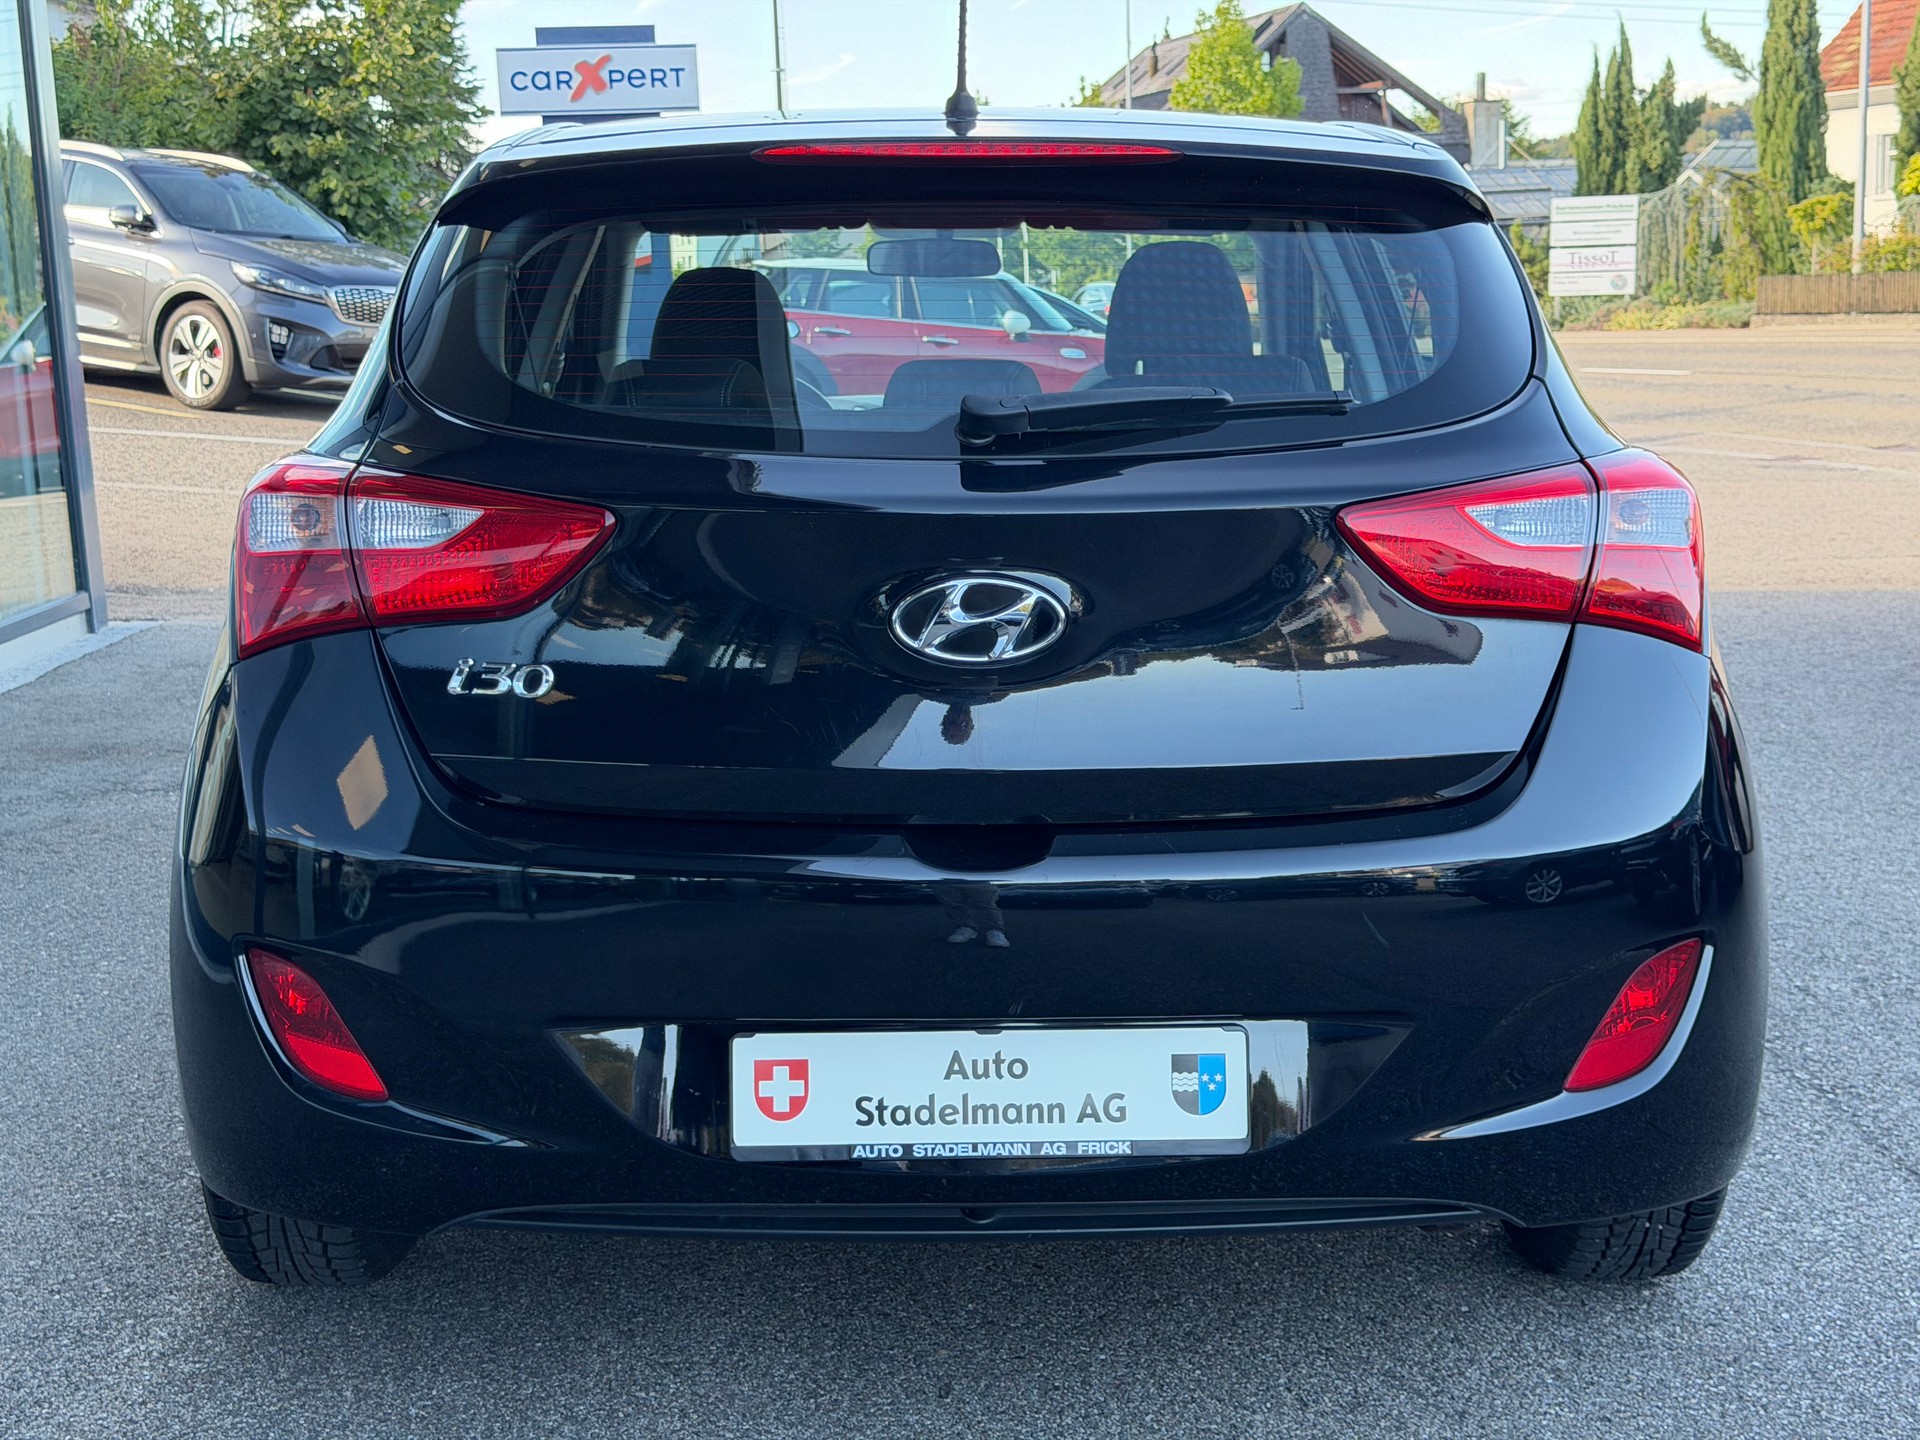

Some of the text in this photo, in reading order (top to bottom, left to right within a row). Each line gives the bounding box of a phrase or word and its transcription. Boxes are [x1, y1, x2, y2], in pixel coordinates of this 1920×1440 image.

[447, 658, 554, 698] i30
[943, 1049, 1029, 1081] Auto
[855, 1092, 1127, 1127] Stadelmann AG
[852, 1141, 1132, 1158] AUTO STADELMANN AG FRICK
